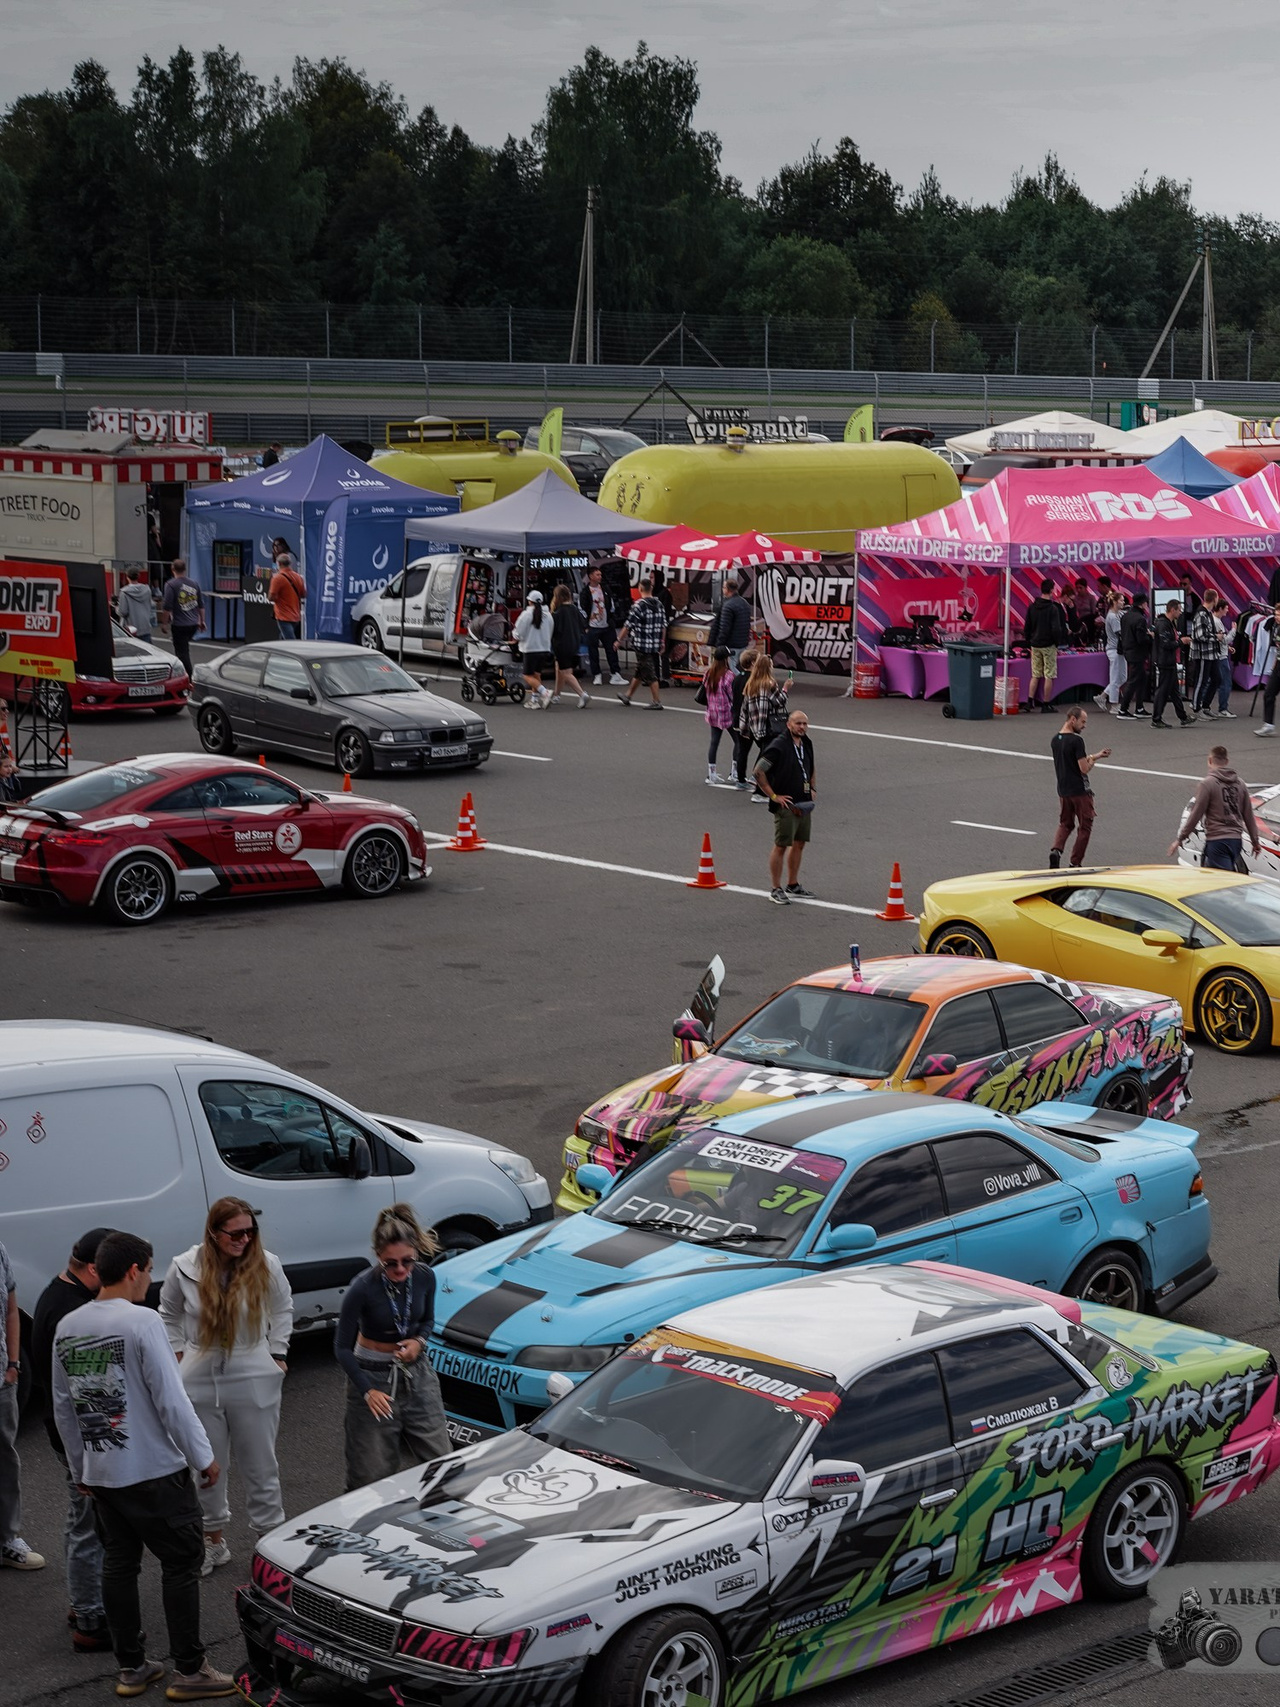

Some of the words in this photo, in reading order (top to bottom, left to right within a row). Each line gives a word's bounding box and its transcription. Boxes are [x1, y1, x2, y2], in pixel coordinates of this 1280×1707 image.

[0, 495, 37, 513] TREET
[41, 497, 81, 521] FOOD
[1026, 494, 1083, 507] RUSSIAN
[1049, 503, 1086, 514] DRIFT
[1089, 489, 1193, 523] RDS
[1045, 511, 1091, 523] SERIES
[860, 532, 918, 556] RUSSIAN
[922, 540, 961, 561] DRIFT
[963, 545, 1004, 564] SHOP
[1019, 541, 1126, 565] RDS-SHOP.RU
[1191, 537, 1230, 554] СТИЛЬ
[1232, 536, 1267, 555] ЗДЕСЬ
[322, 521, 338, 604] invoke
[0, 581, 58, 614] DRIFT
[243, 589, 274, 604] invok
[785, 576, 854, 605] DRIFT
[25, 616, 51, 631] EXPO
[816, 605, 845, 619] EXPO
[903, 599, 965, 623] СТИЛЬ
[796, 621, 851, 641] TRACK
[804, 640, 854, 659] MODE
[234, 830, 251, 841] Red
[251, 829, 274, 840] Stars
[707, 1146, 783, 1169] CONTEST
[714, 1137, 750, 1153] ADM
[748, 1143, 790, 1162] DRIFT
[758, 1185, 826, 1215] 37
[666, 1345, 698, 1358] DRIFT
[681, 1355, 754, 1382] TRACK
[737, 1373, 810, 1401] MODE
[986, 1399, 1048, 1429] Смалюжак
[1048, 1397, 1059, 1411] В
[1009, 1367, 1264, 1482] FORD-MARKET
[445, 1420, 482, 1445] RIEC
[810, 1497, 848, 1518] STYLE
[1022, 1540, 1054, 1557] STREAM
[615, 1567, 661, 1592] AIN'T
[662, 1542, 735, 1574] TALKING
[615, 1578, 664, 1604] JUST
[665, 1551, 742, 1586] WORKING
[886, 1537, 958, 1596] 21
[775, 1619, 811, 1640] DESIGN
[811, 1609, 849, 1629] STUDIO
[312, 1647, 372, 1684] RACING
